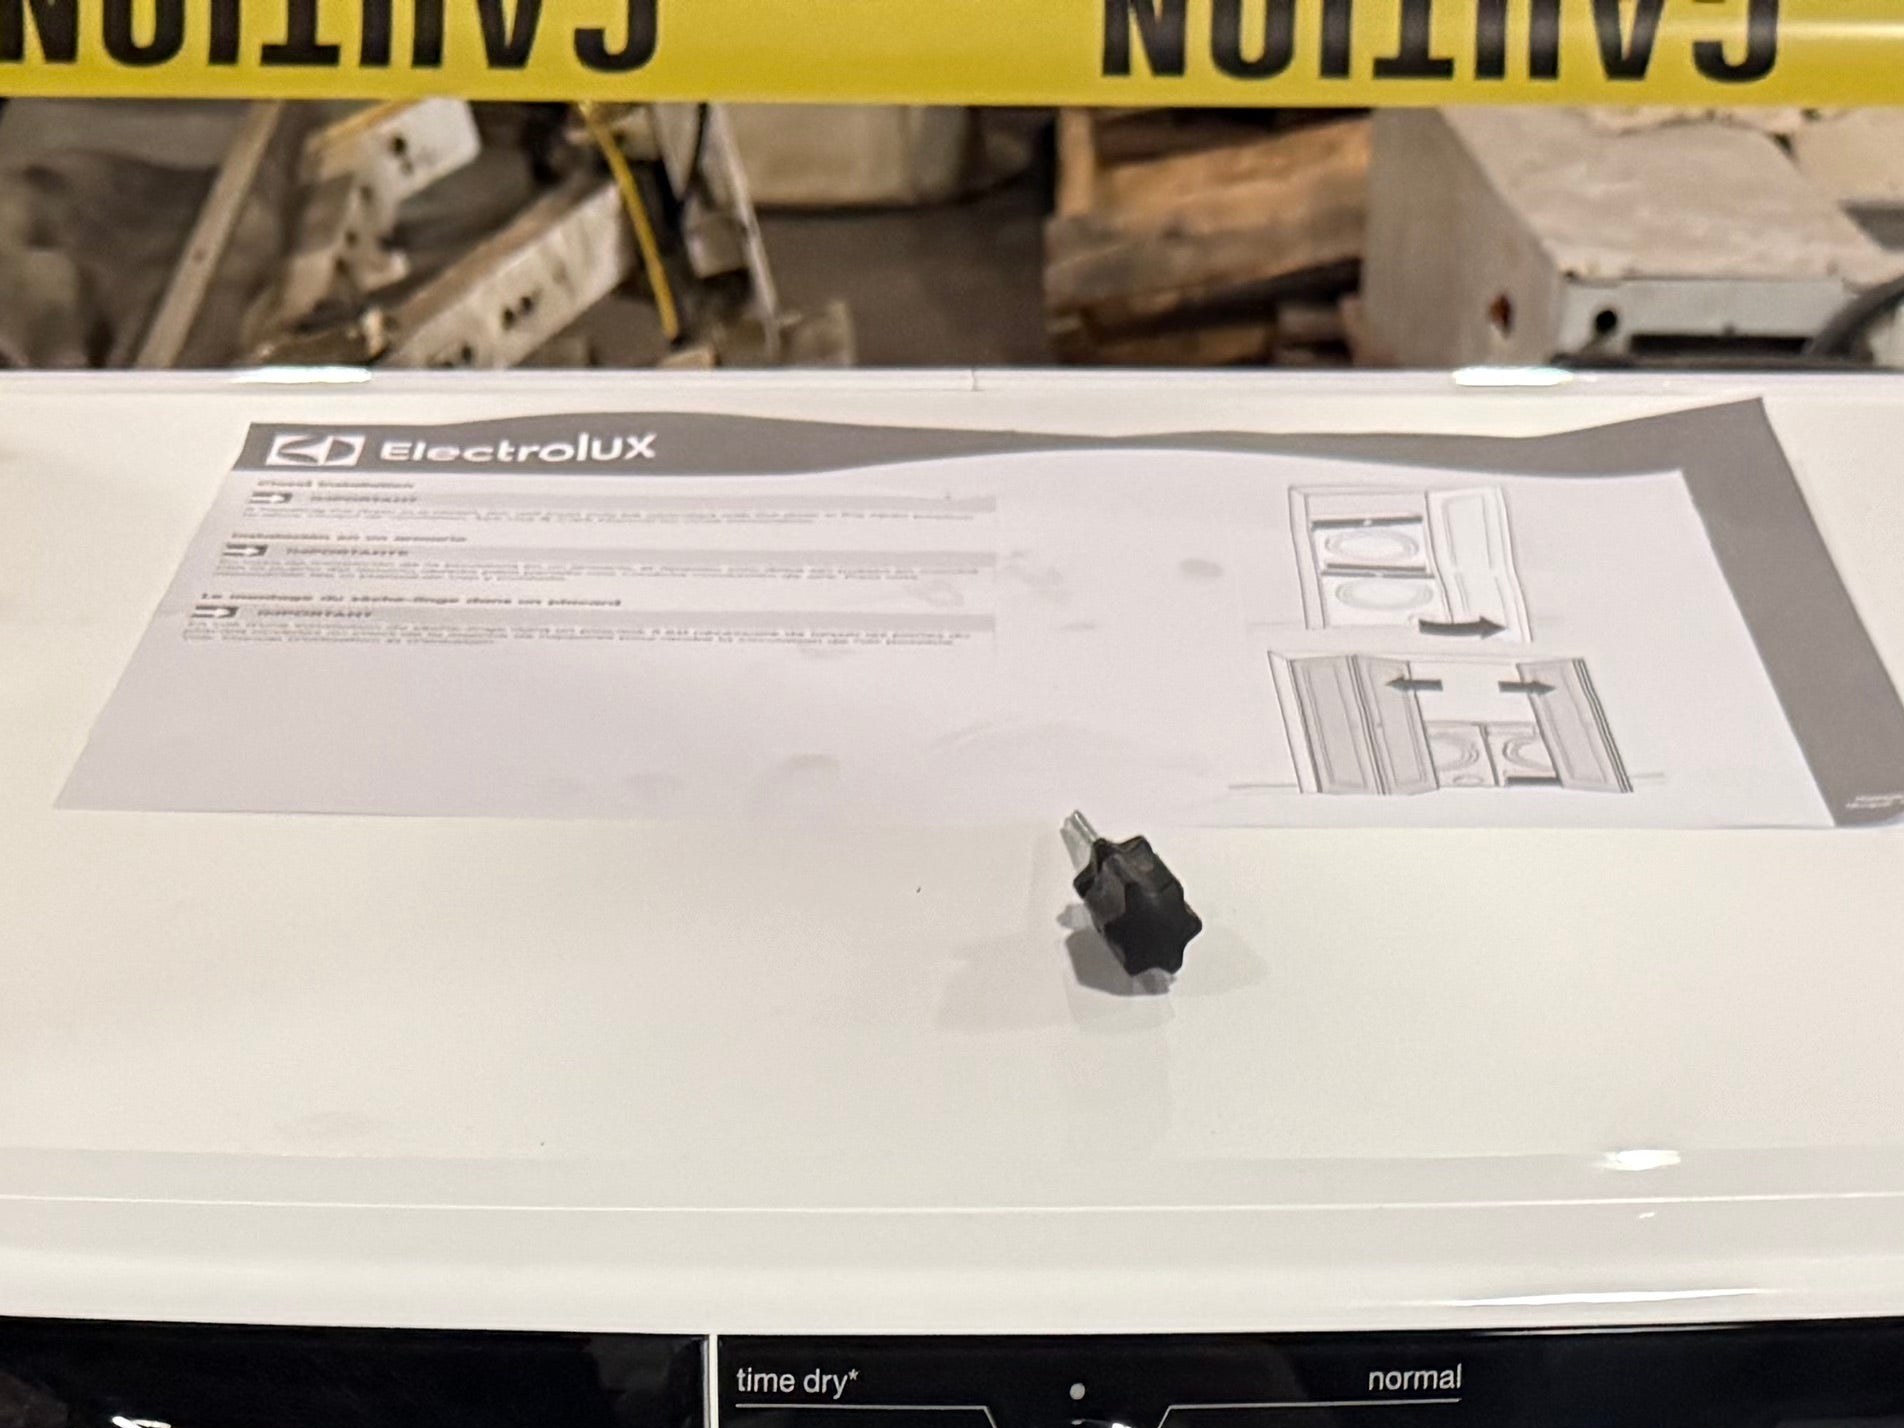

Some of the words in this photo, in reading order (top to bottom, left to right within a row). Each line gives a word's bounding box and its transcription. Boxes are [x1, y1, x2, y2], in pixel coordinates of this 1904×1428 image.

[378, 432, 658, 465] Electrolux
[736, 1366, 796, 1393] time
[1368, 1363, 1462, 1391] normal
